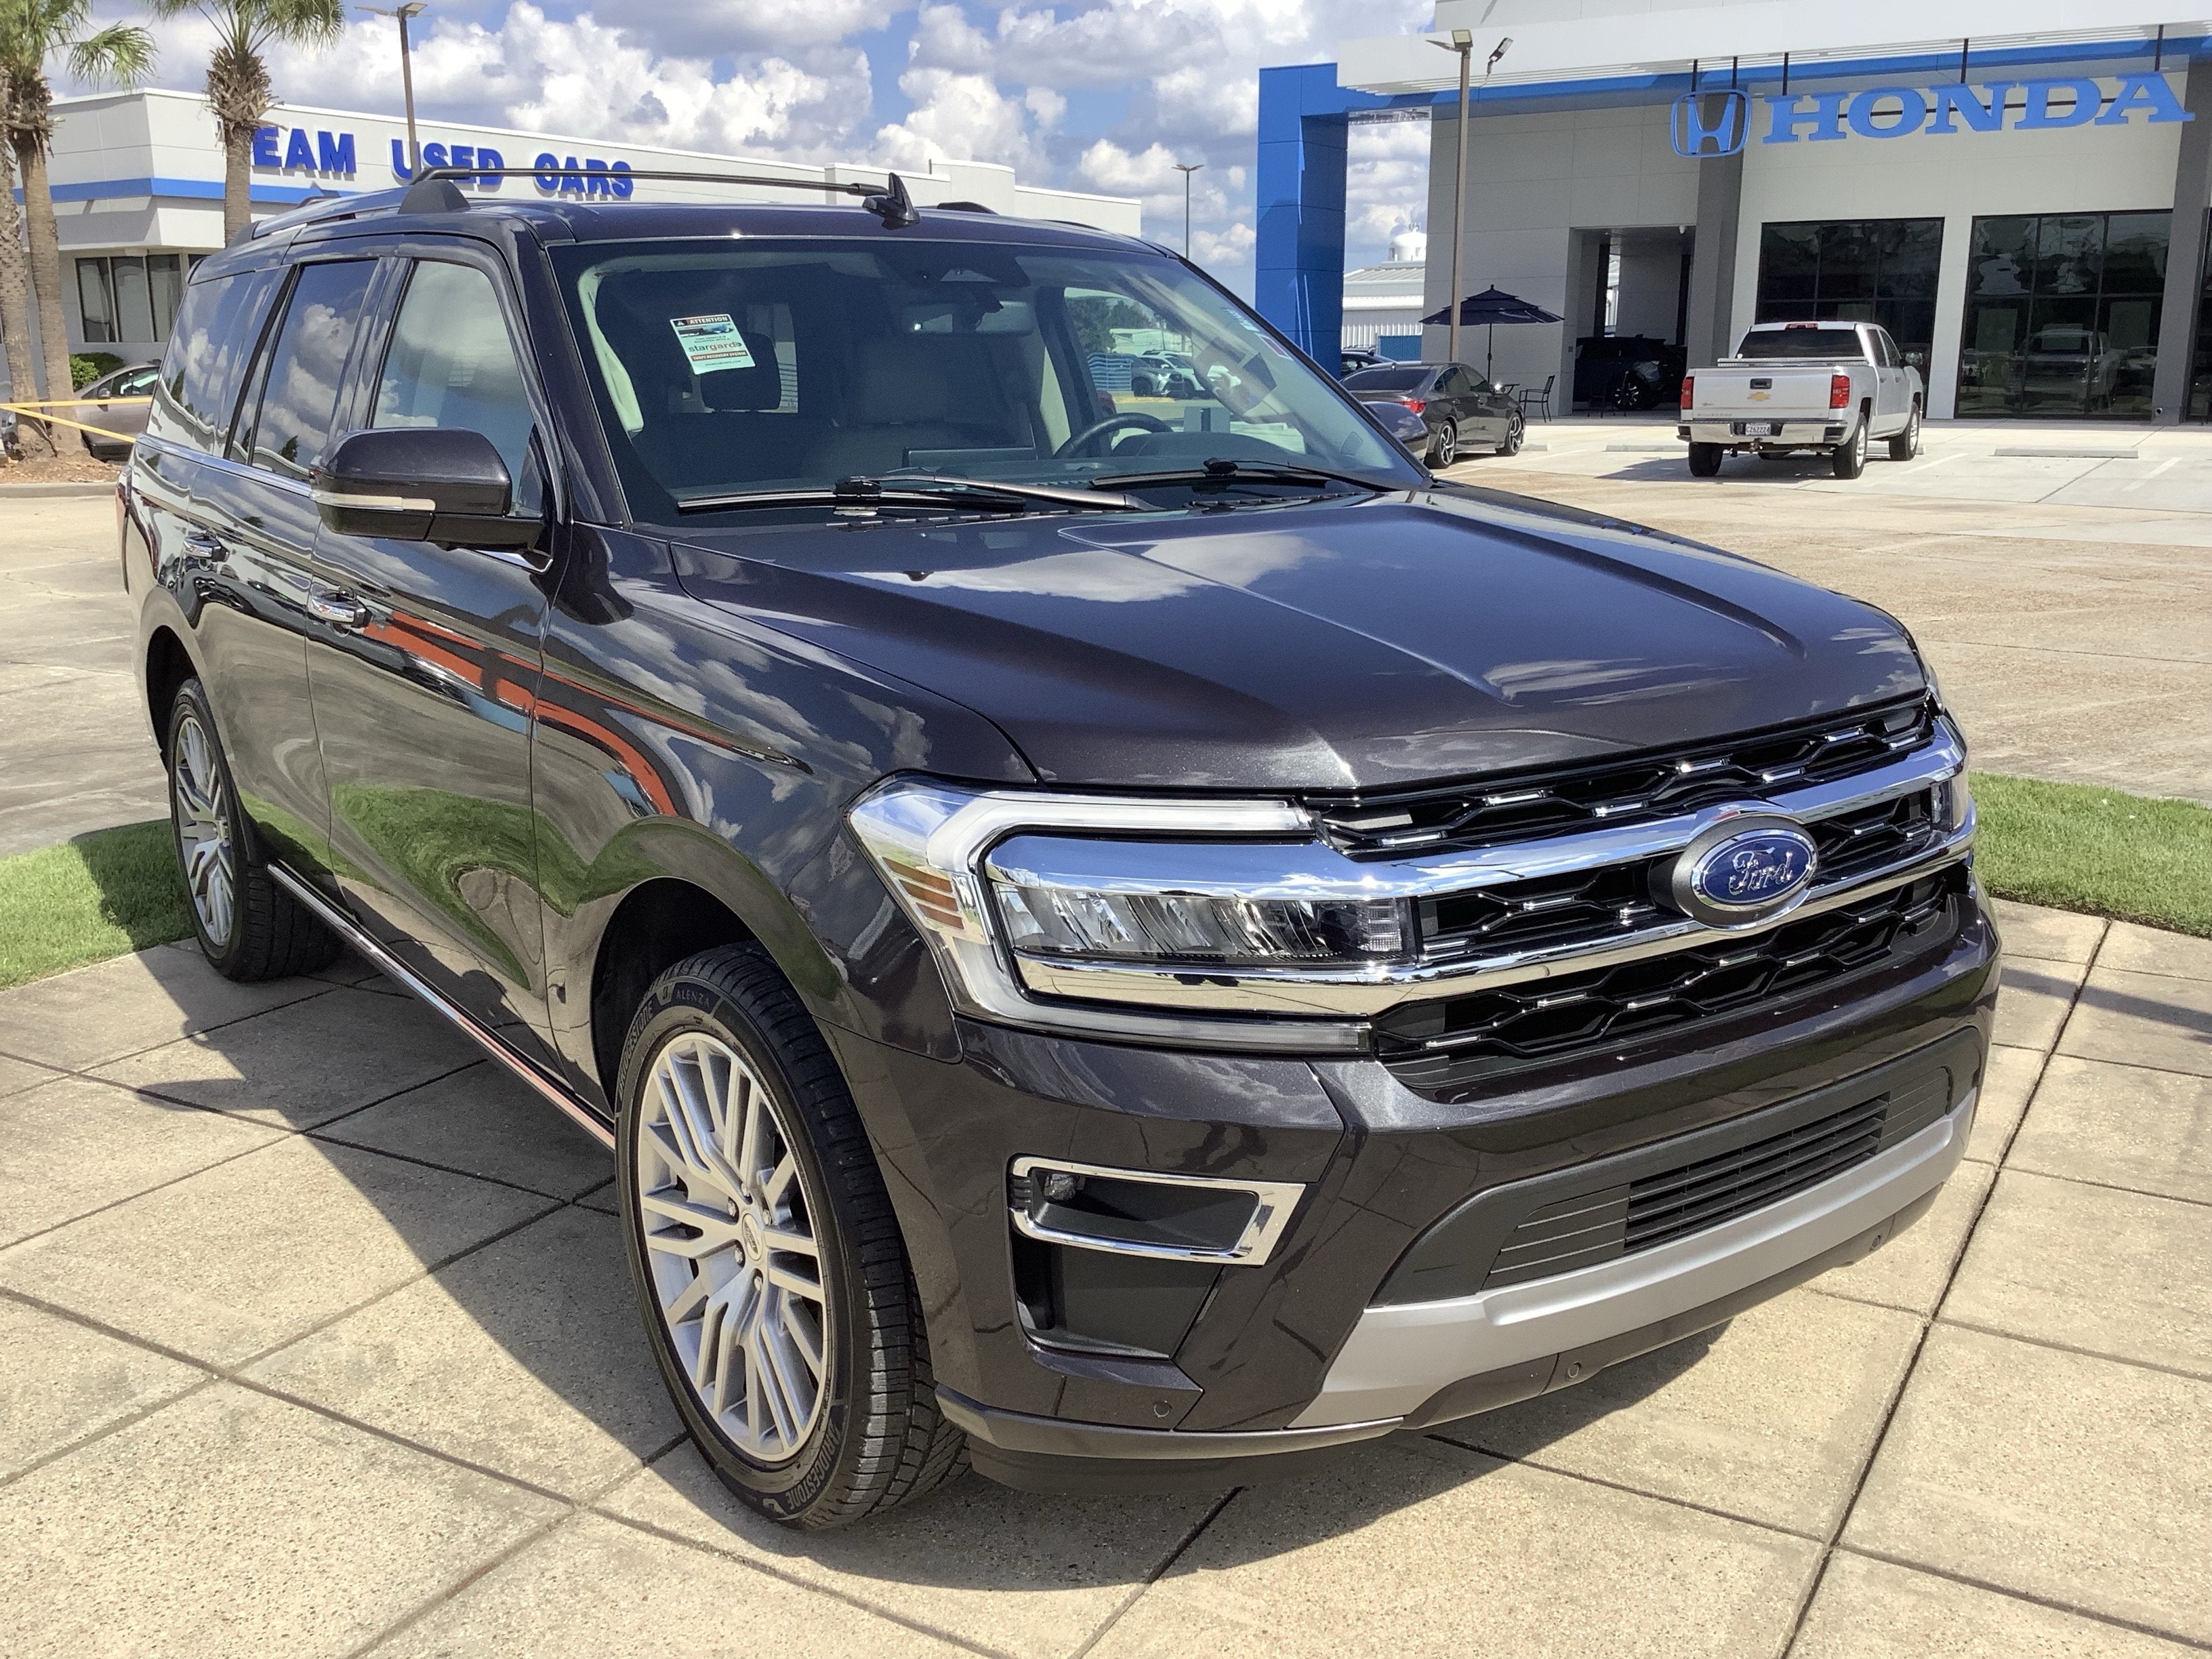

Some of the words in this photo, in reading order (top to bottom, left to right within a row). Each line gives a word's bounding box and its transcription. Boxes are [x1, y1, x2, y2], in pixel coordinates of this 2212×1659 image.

[1763, 72, 2196, 144] HONDA
[217, 121, 356, 174] EAM
[391, 138, 504, 186] USED
[534, 152, 634, 199] CARS
[690, 316, 728, 325] ATTENTION
[689, 341, 736, 352] stargard
[1729, 847, 1793, 896] Ford
[676, 988, 711, 1009] ALENZA
